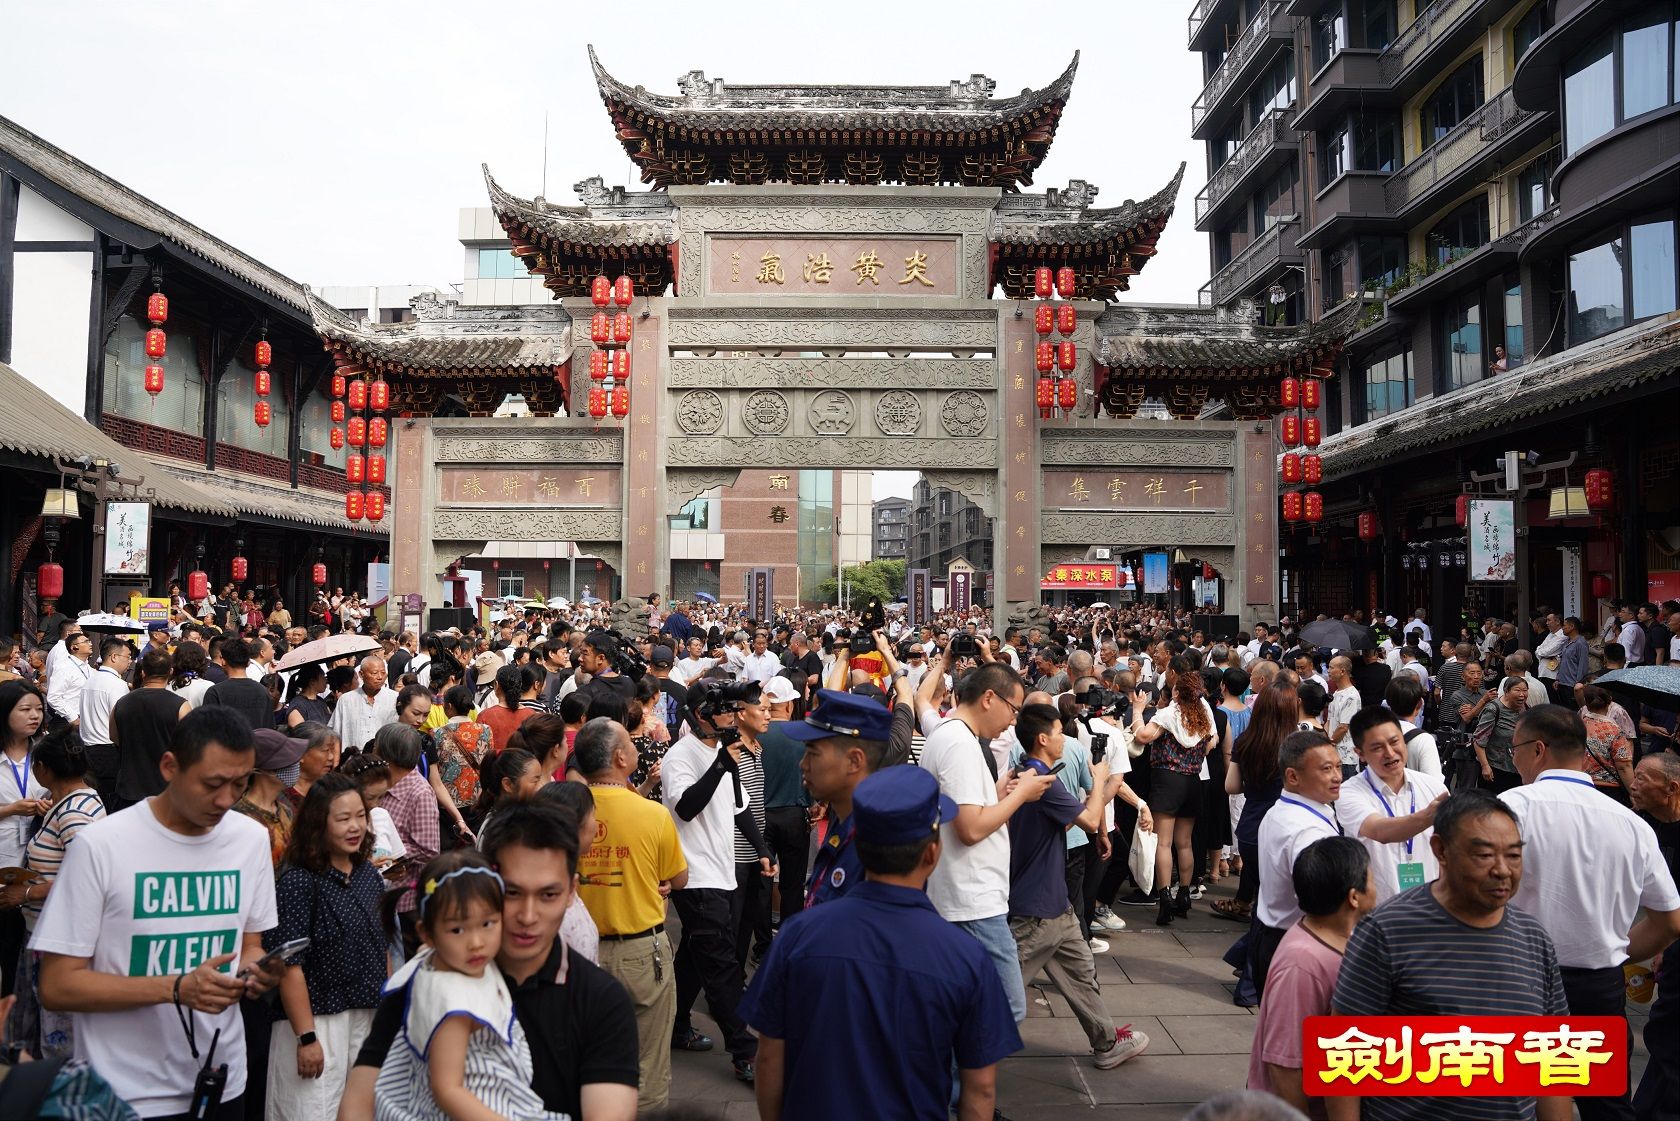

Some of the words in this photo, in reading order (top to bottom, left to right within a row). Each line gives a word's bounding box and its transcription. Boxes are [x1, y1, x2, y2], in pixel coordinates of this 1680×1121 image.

[767, 473, 790, 523] 南春
[1068, 477, 1204, 504] 千祥雲集
[142, 874, 237, 914] CALVIN
